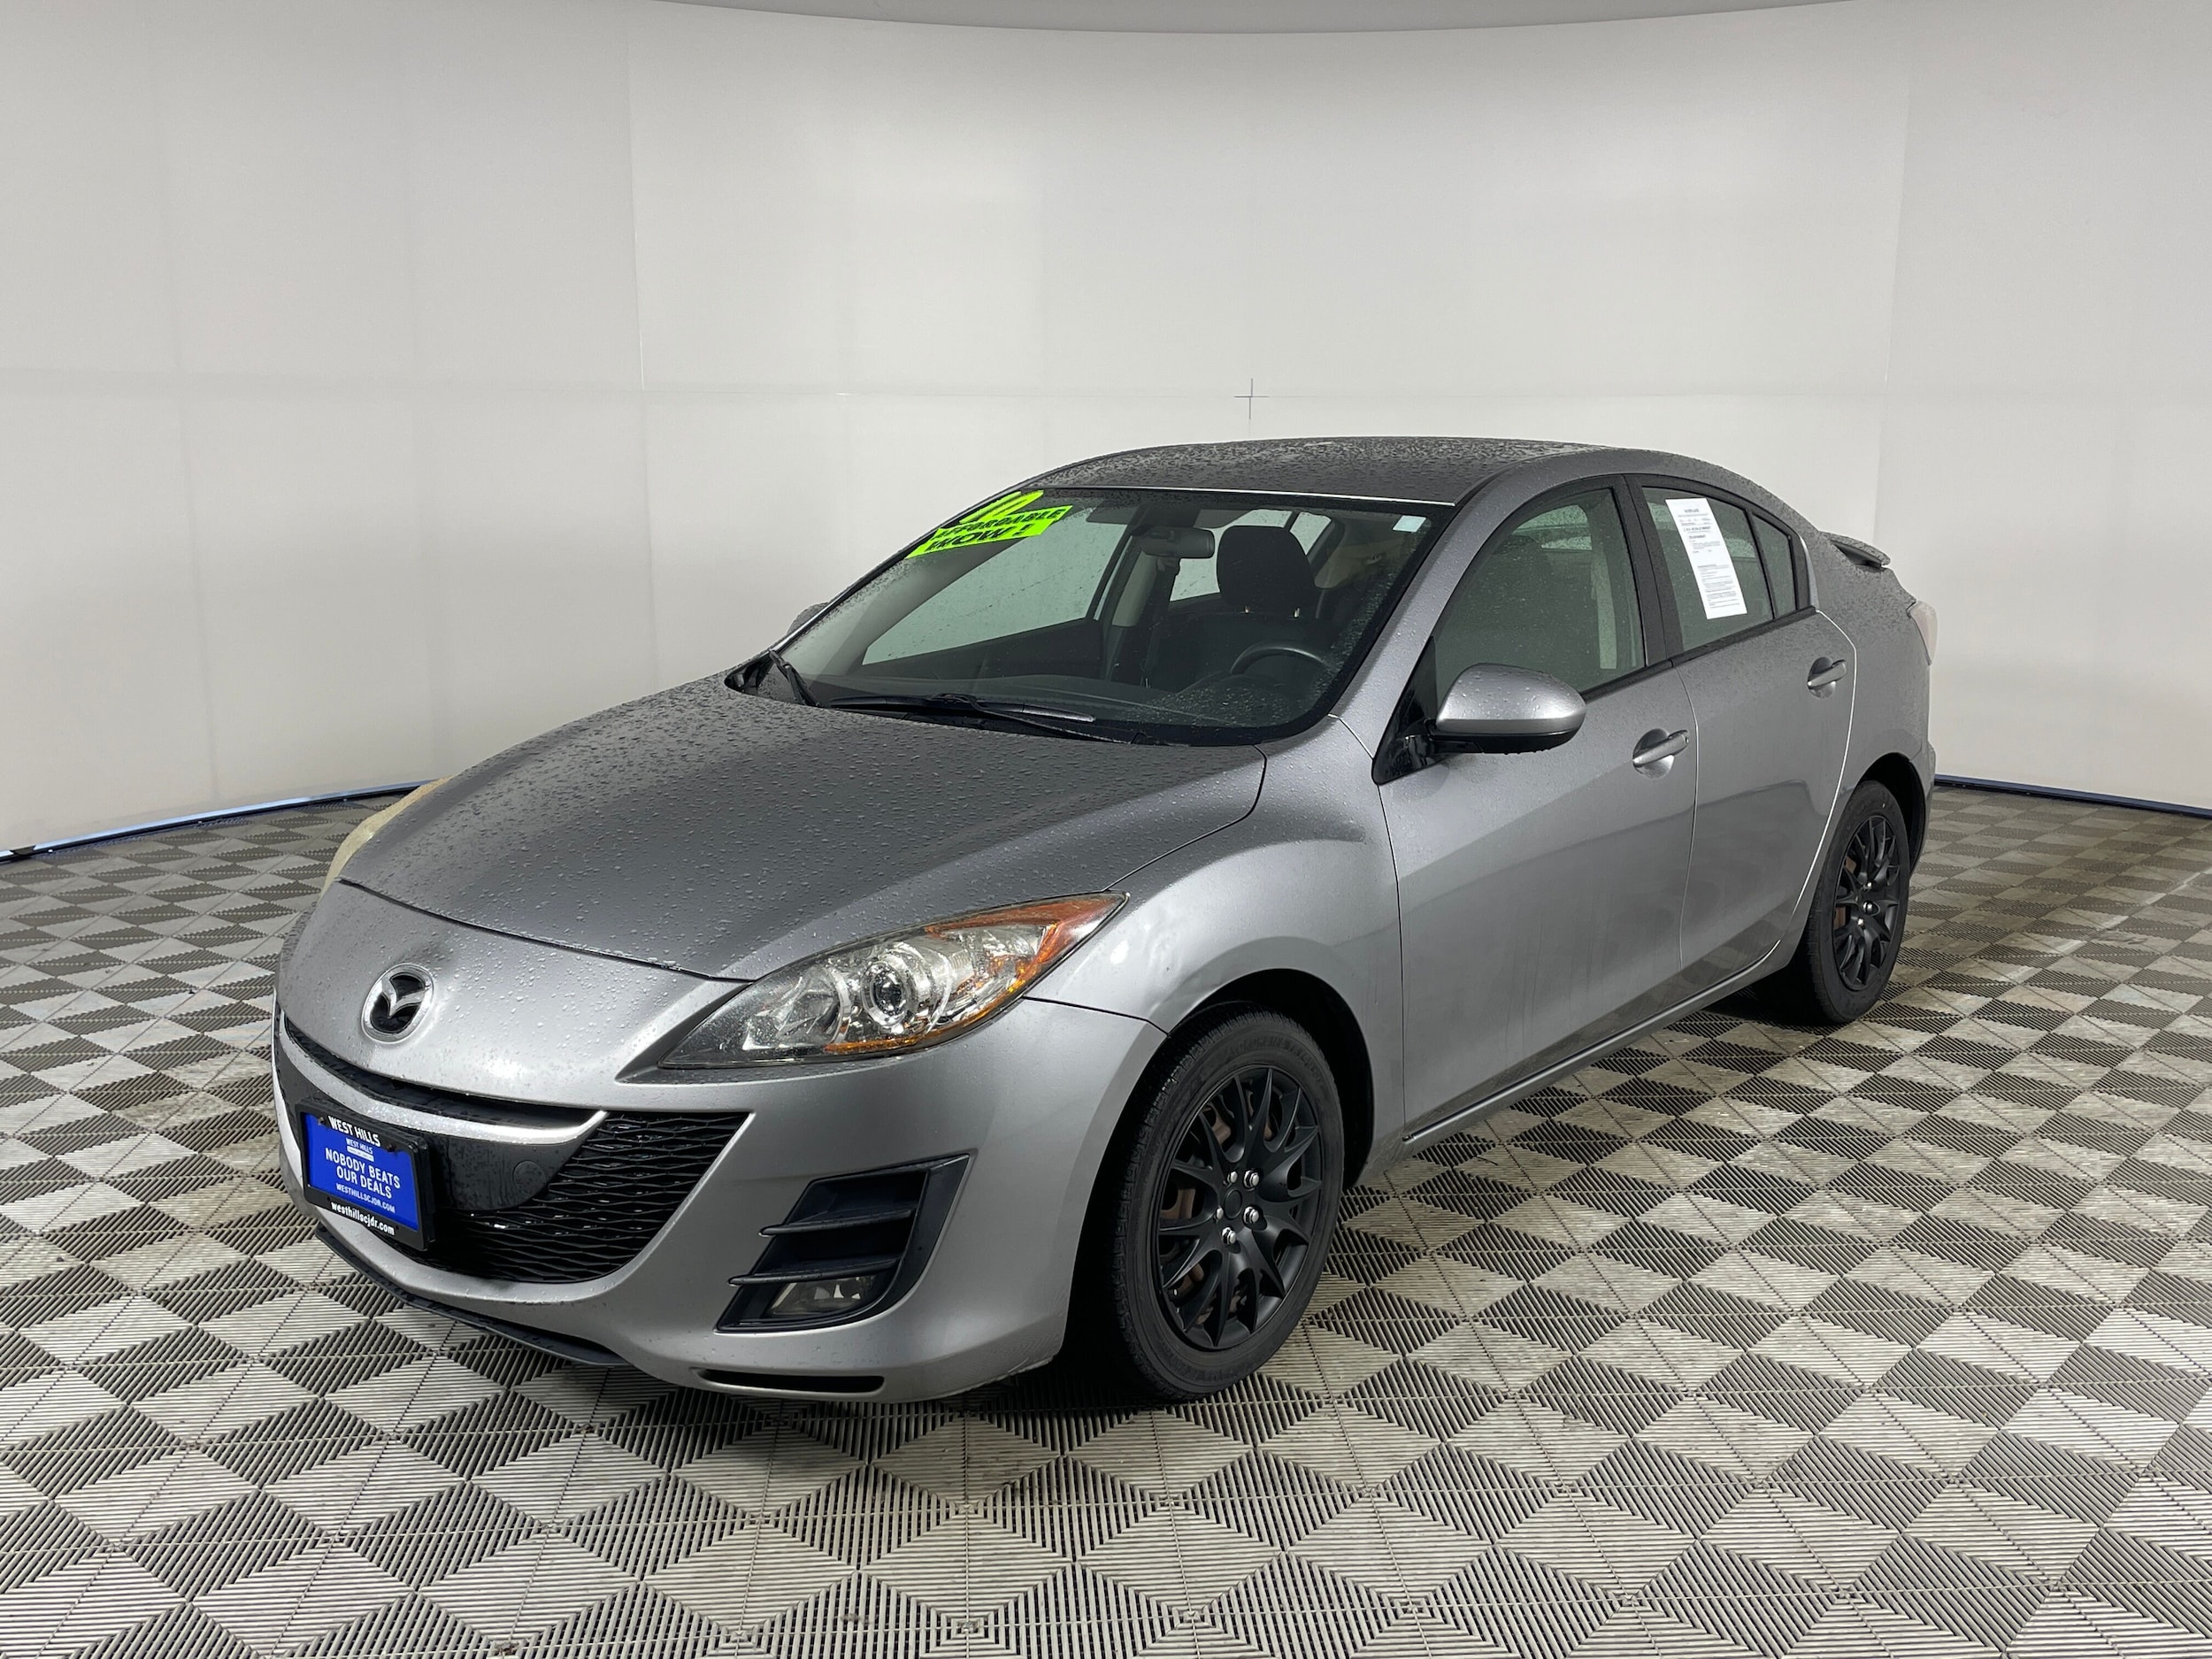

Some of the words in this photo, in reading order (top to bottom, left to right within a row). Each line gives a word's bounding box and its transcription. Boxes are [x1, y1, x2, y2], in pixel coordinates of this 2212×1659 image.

[328, 1116, 353, 1136] WEST
[353, 1126, 380, 1147] HILLS
[346, 1138, 359, 1148] WEST
[359, 1143, 373, 1155] HILLS
[325, 1148, 365, 1174] NOBODY
[369, 1165, 401, 1189] BEATS
[336, 1166, 357, 1185] OUR
[360, 1177, 392, 1199] DEALS
[336, 1183, 396, 1213] WESTHILLSCJDR.COM
[331, 1202, 395, 1235] westhillscjdr.com
